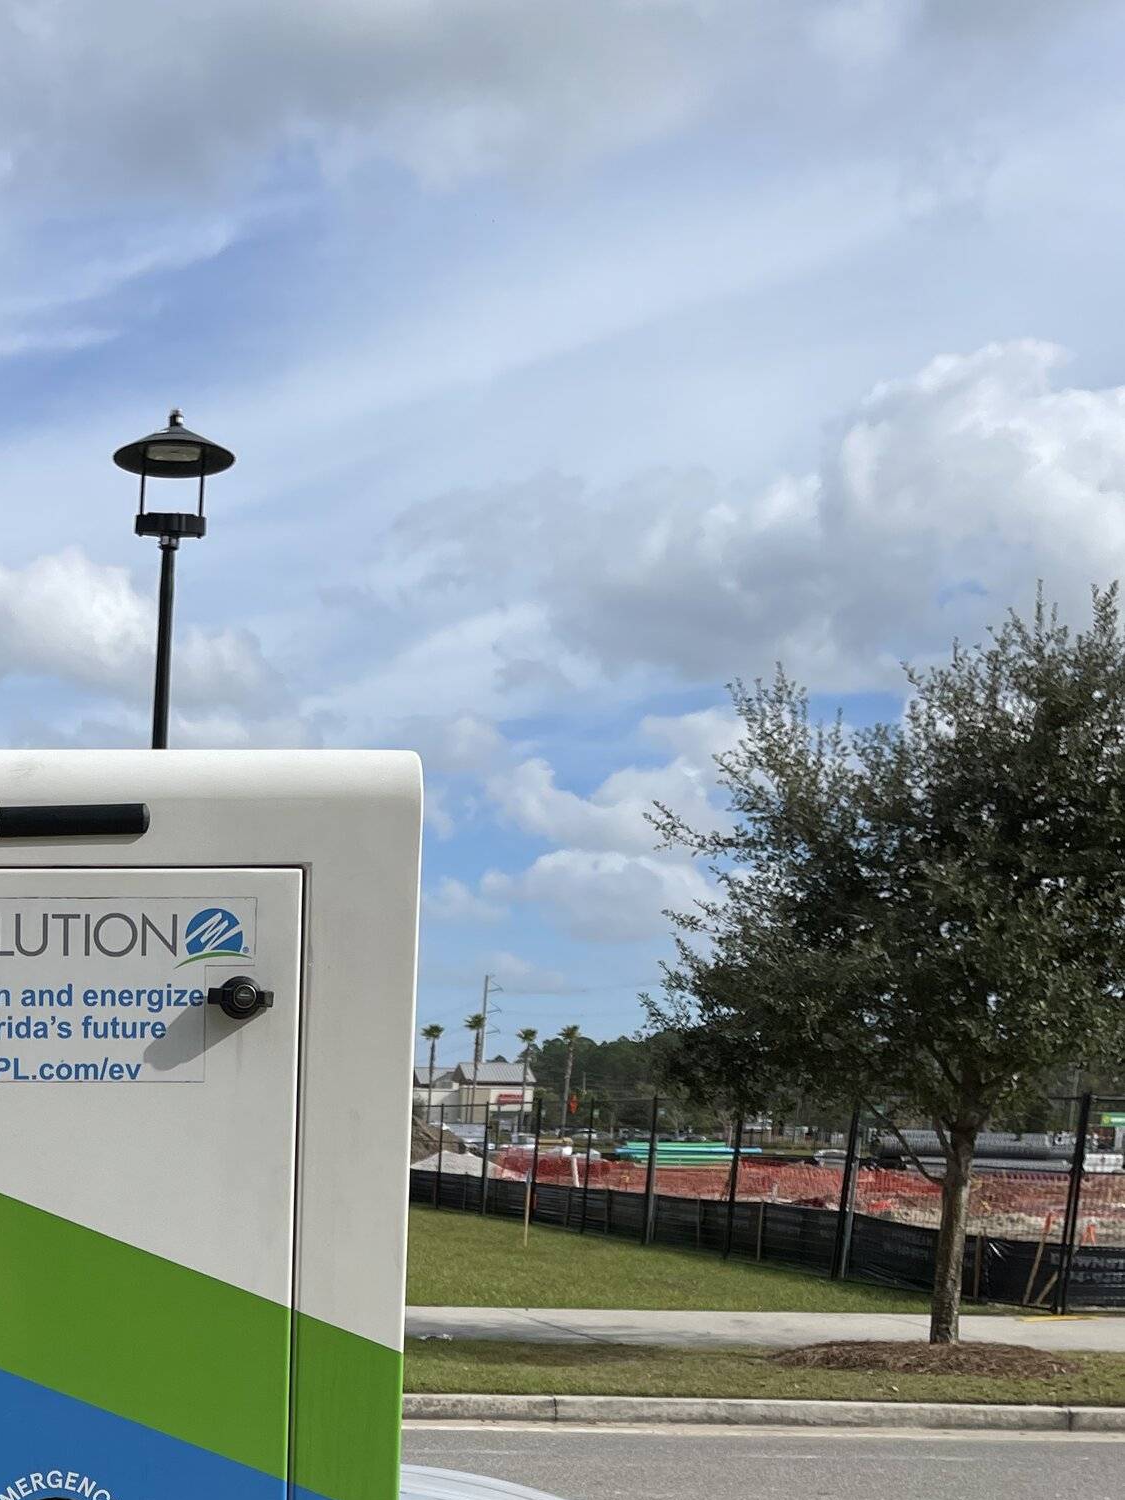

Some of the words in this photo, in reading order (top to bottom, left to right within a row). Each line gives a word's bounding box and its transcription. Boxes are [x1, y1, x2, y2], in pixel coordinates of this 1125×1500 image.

[21, 983, 73, 1007] and
[82, 983, 204, 1013] energize
[82, 1015, 167, 1039] future
